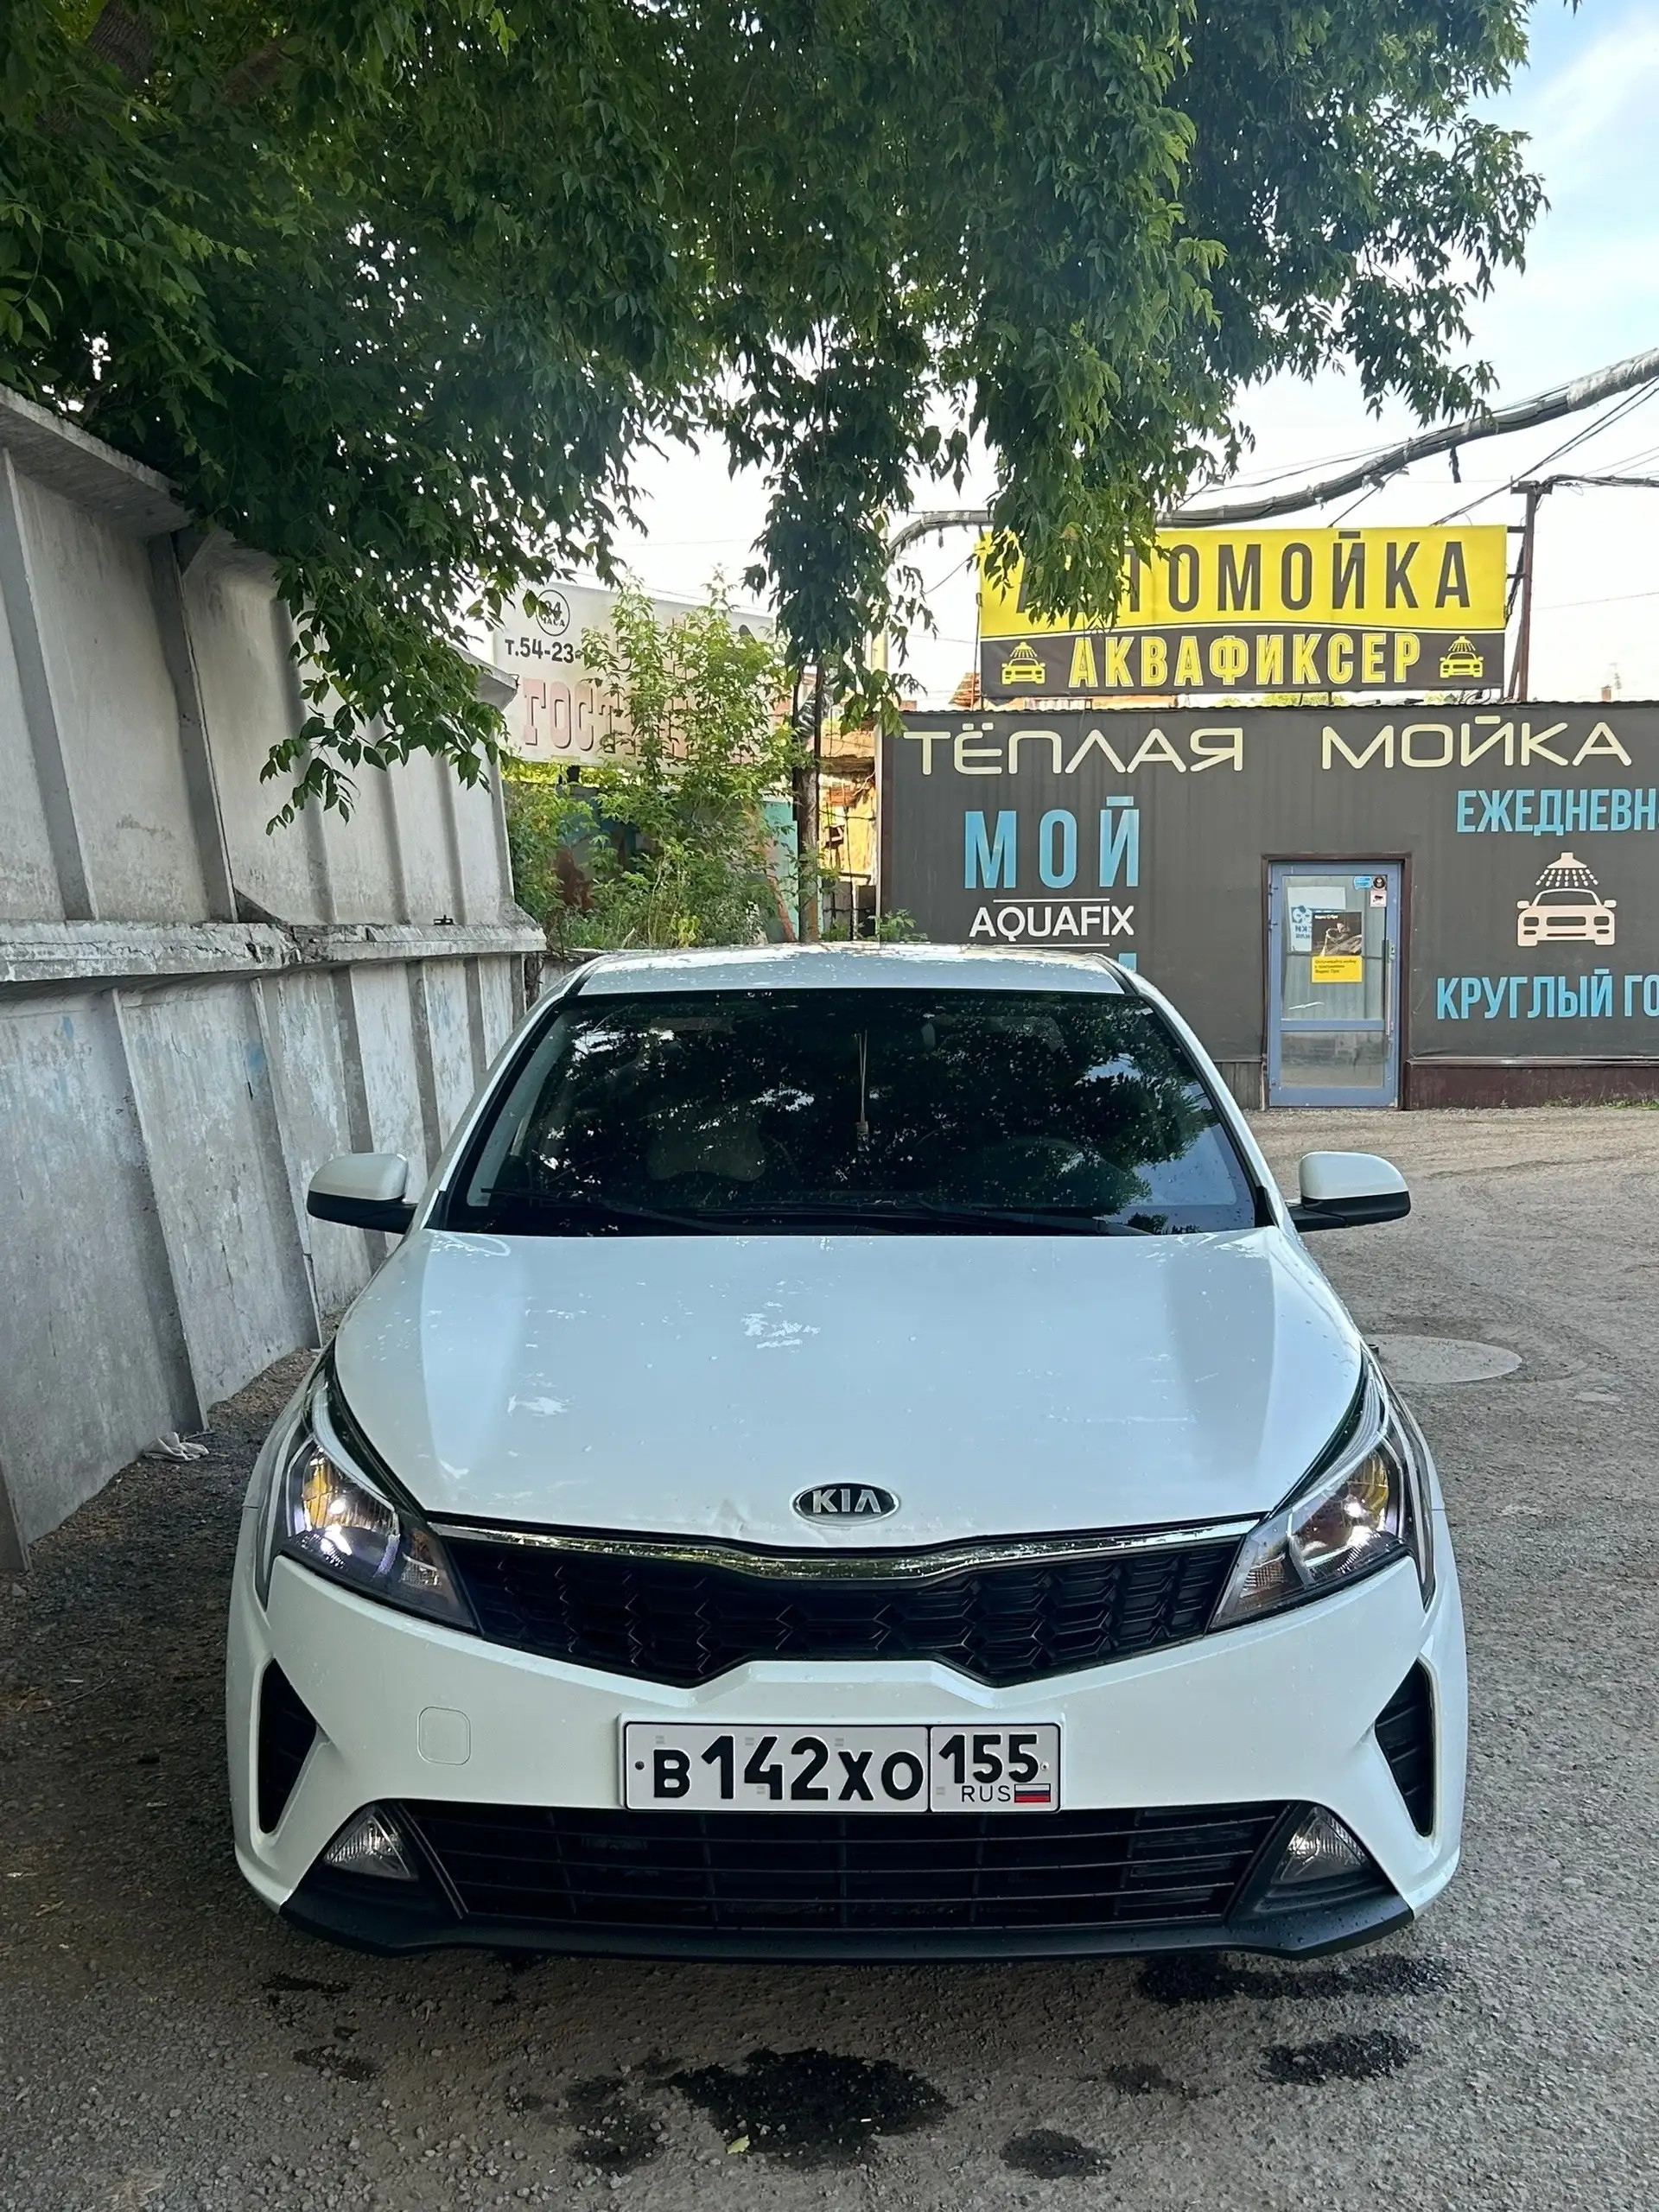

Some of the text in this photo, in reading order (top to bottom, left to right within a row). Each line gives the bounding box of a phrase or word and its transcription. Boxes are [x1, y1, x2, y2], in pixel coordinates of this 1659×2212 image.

[1016, 530, 1471, 613] ТОМОЙКА
[1068, 632, 1421, 689] АКВАФИКСЕР
[903, 715, 1632, 775] ТЁПЛАЯ МОЙКА
[1456, 787, 1659, 836] ЕЖЕДНЕВН
[964, 796, 1140, 889] МОЙ
[968, 905, 1135, 942] AQUAFIX
[1436, 968, 1613, 1020] КРУГЛЫЙ
[810, 1488, 882, 1515] KIA
[938, 1732, 1039, 1784] 155
[961, 1783, 1011, 1802] RUS
